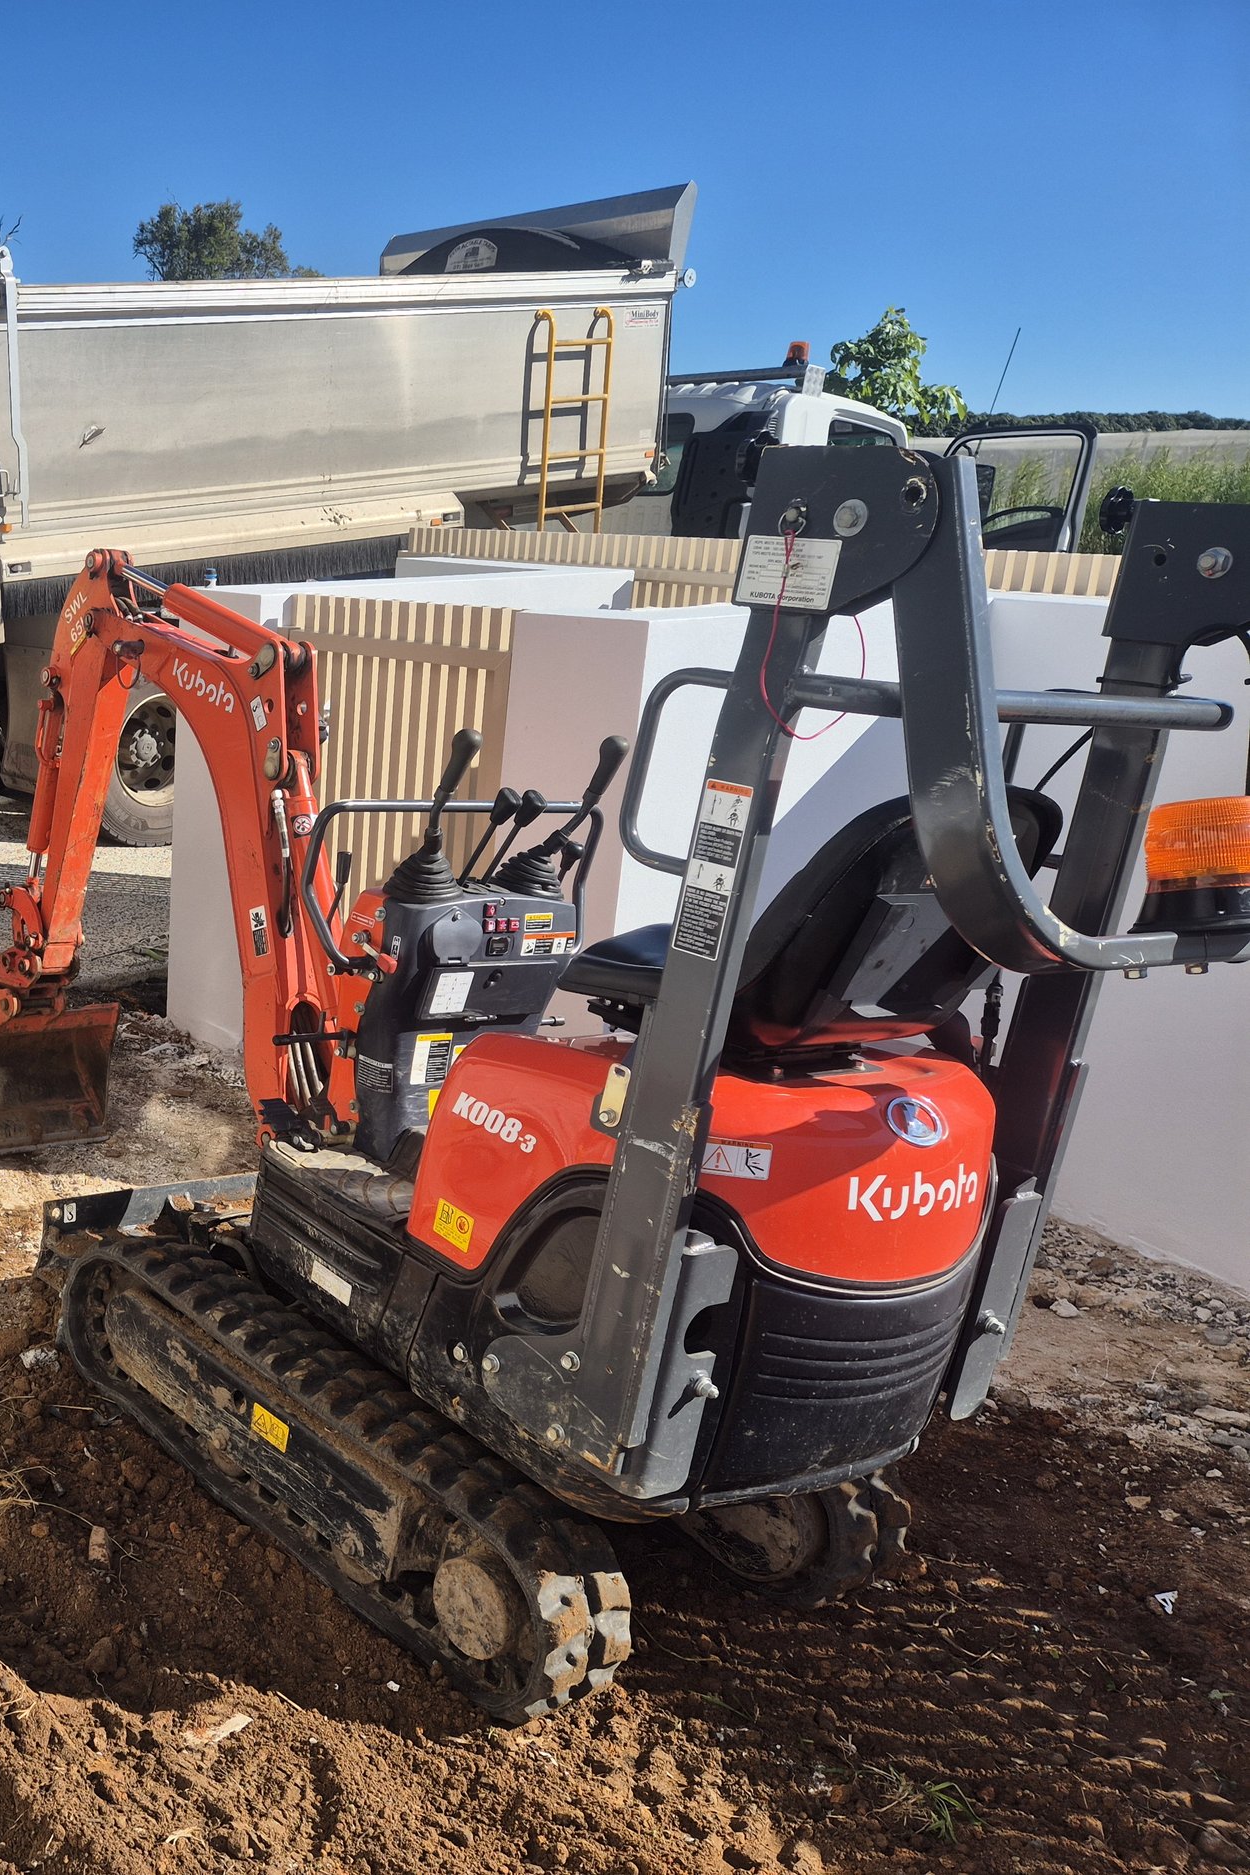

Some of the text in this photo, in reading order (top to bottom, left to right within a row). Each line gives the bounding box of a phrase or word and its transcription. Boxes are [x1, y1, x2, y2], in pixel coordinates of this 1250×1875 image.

[64, 591, 88, 624] SWL
[749, 590, 776, 600] KUBOTA
[172, 658, 235, 713] Kubota
[452, 1091, 537, 1154] K008-3
[848, 1163, 978, 1222] Kubota
